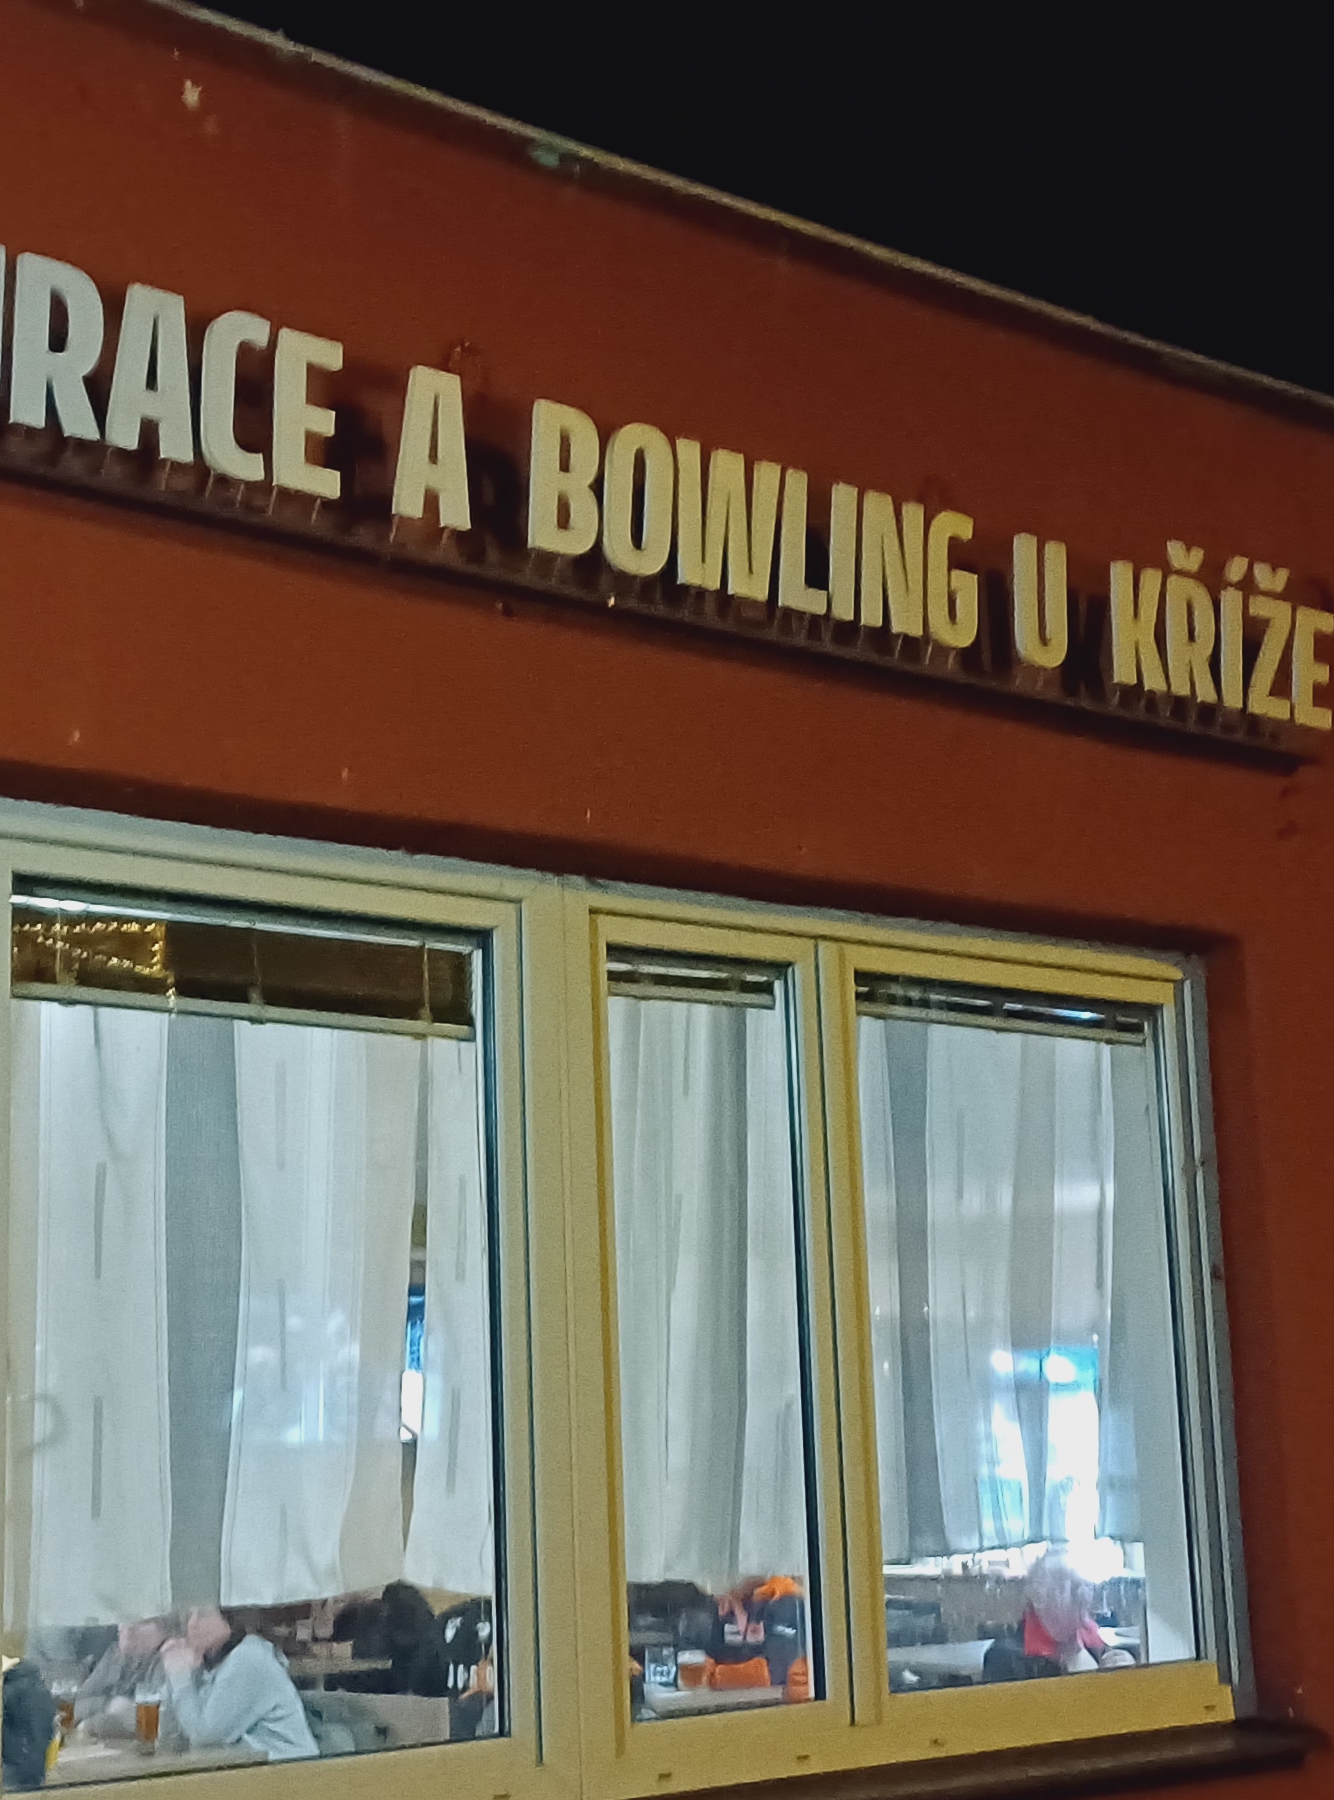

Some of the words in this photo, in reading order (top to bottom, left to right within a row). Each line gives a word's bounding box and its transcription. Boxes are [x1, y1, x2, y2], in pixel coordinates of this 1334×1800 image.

[392, 365, 471, 532] A
[527, 399, 979, 649] BOWLING
[1013, 533, 1067, 668] U
[1109, 540, 1334, 729] KŘÍŽE
